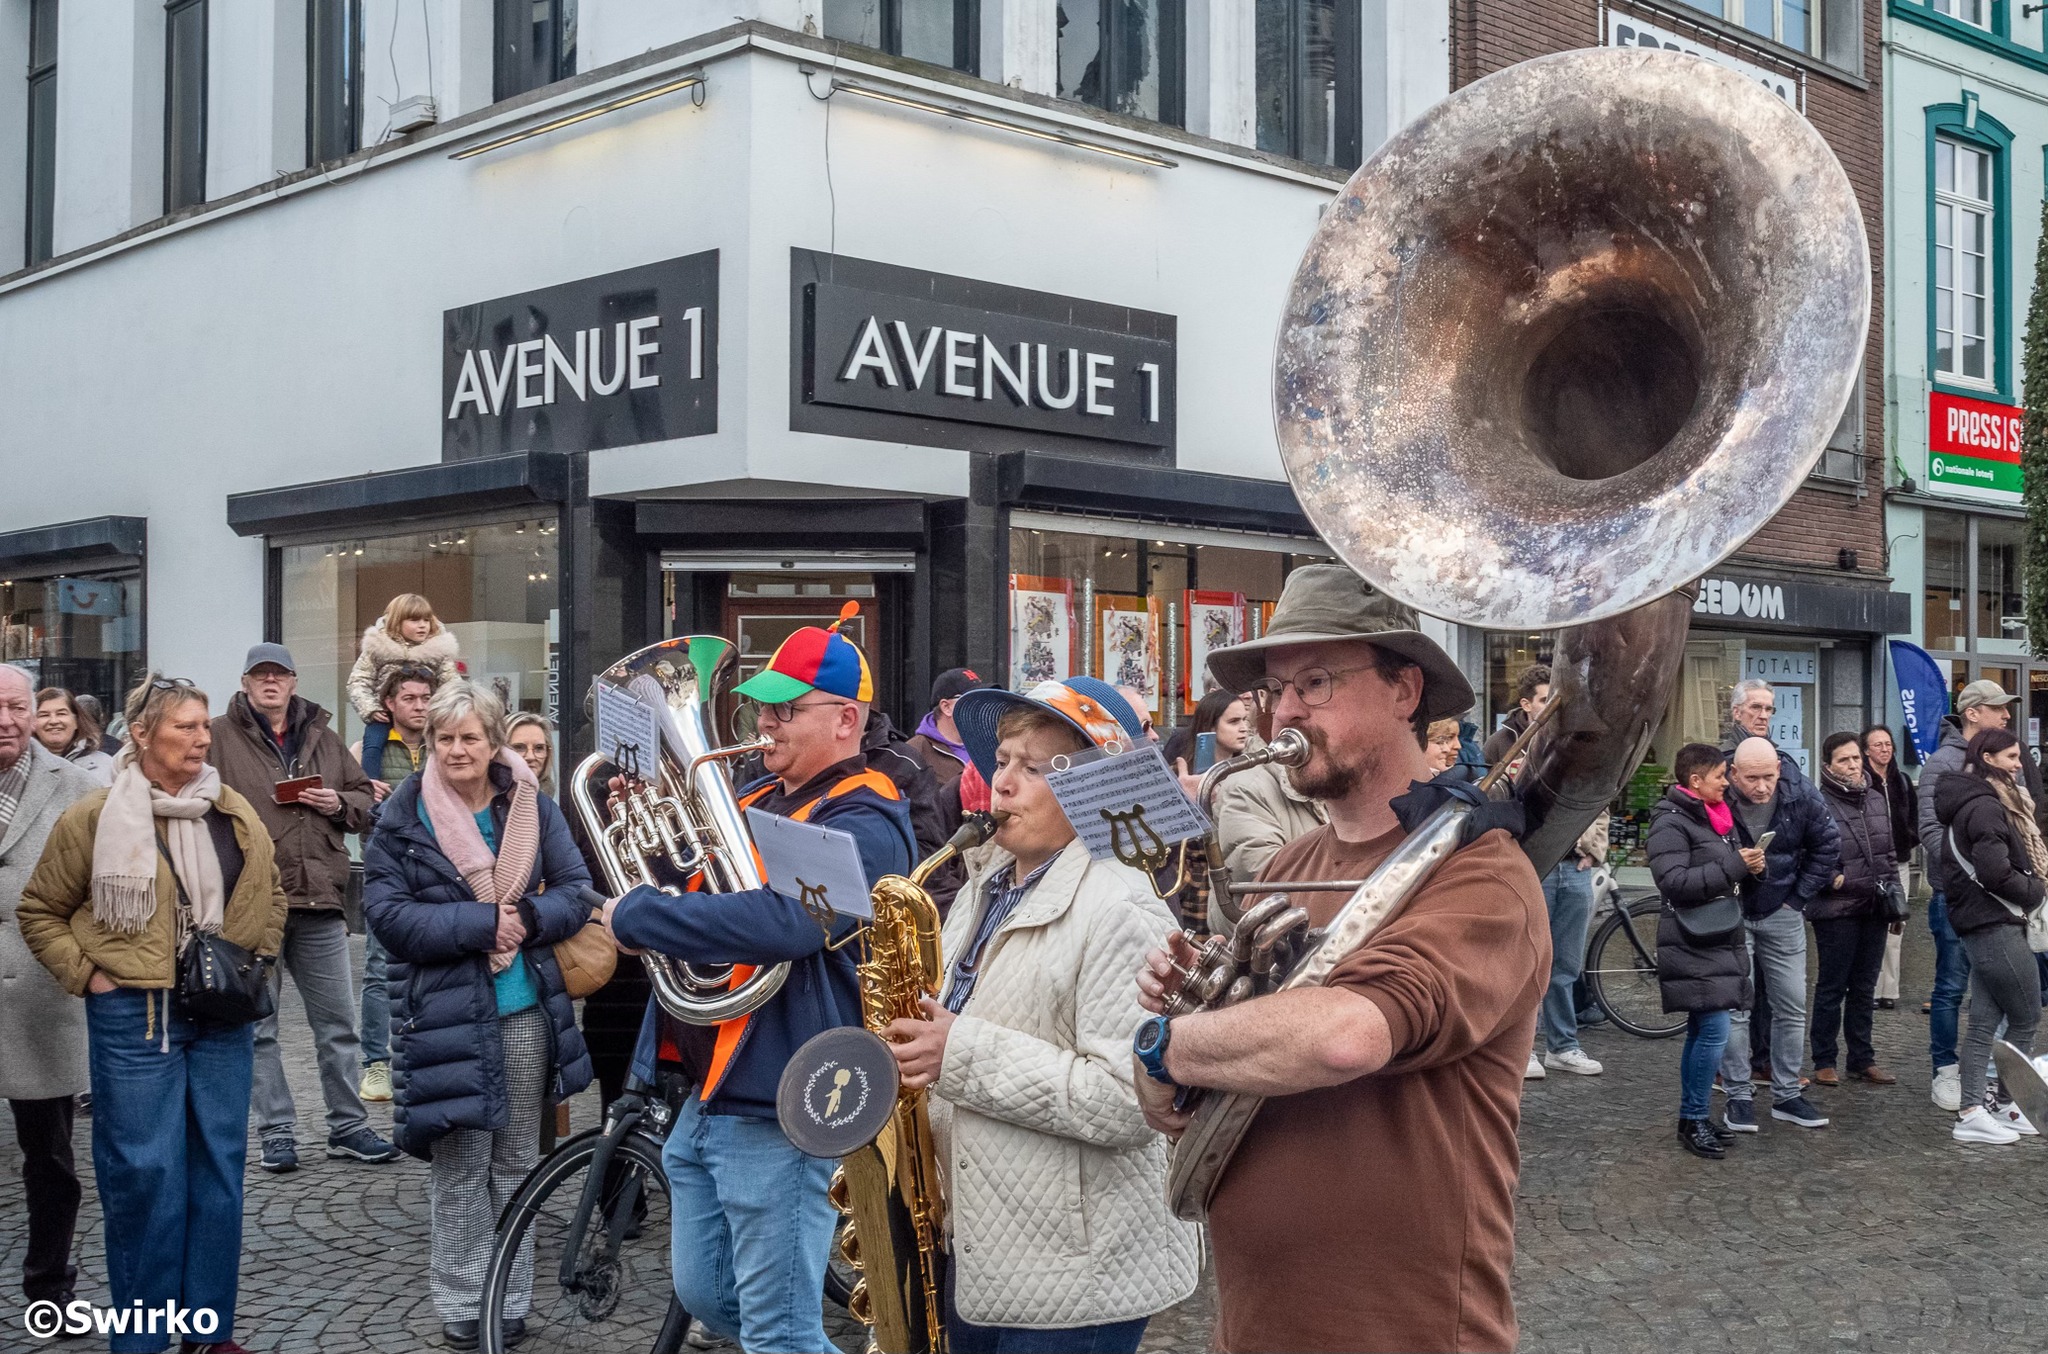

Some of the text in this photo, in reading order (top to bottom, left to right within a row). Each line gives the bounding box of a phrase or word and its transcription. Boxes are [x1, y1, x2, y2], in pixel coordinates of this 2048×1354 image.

[448, 307, 702, 419] AVENUE 1
[844, 315, 1160, 422] AVENUE 1
[1945, 465, 1975, 476] nationale
[1693, 578, 1785, 620] EEDOM
[1746, 657, 1814, 675] TOTALE
[1781, 694, 1799, 709] IT
